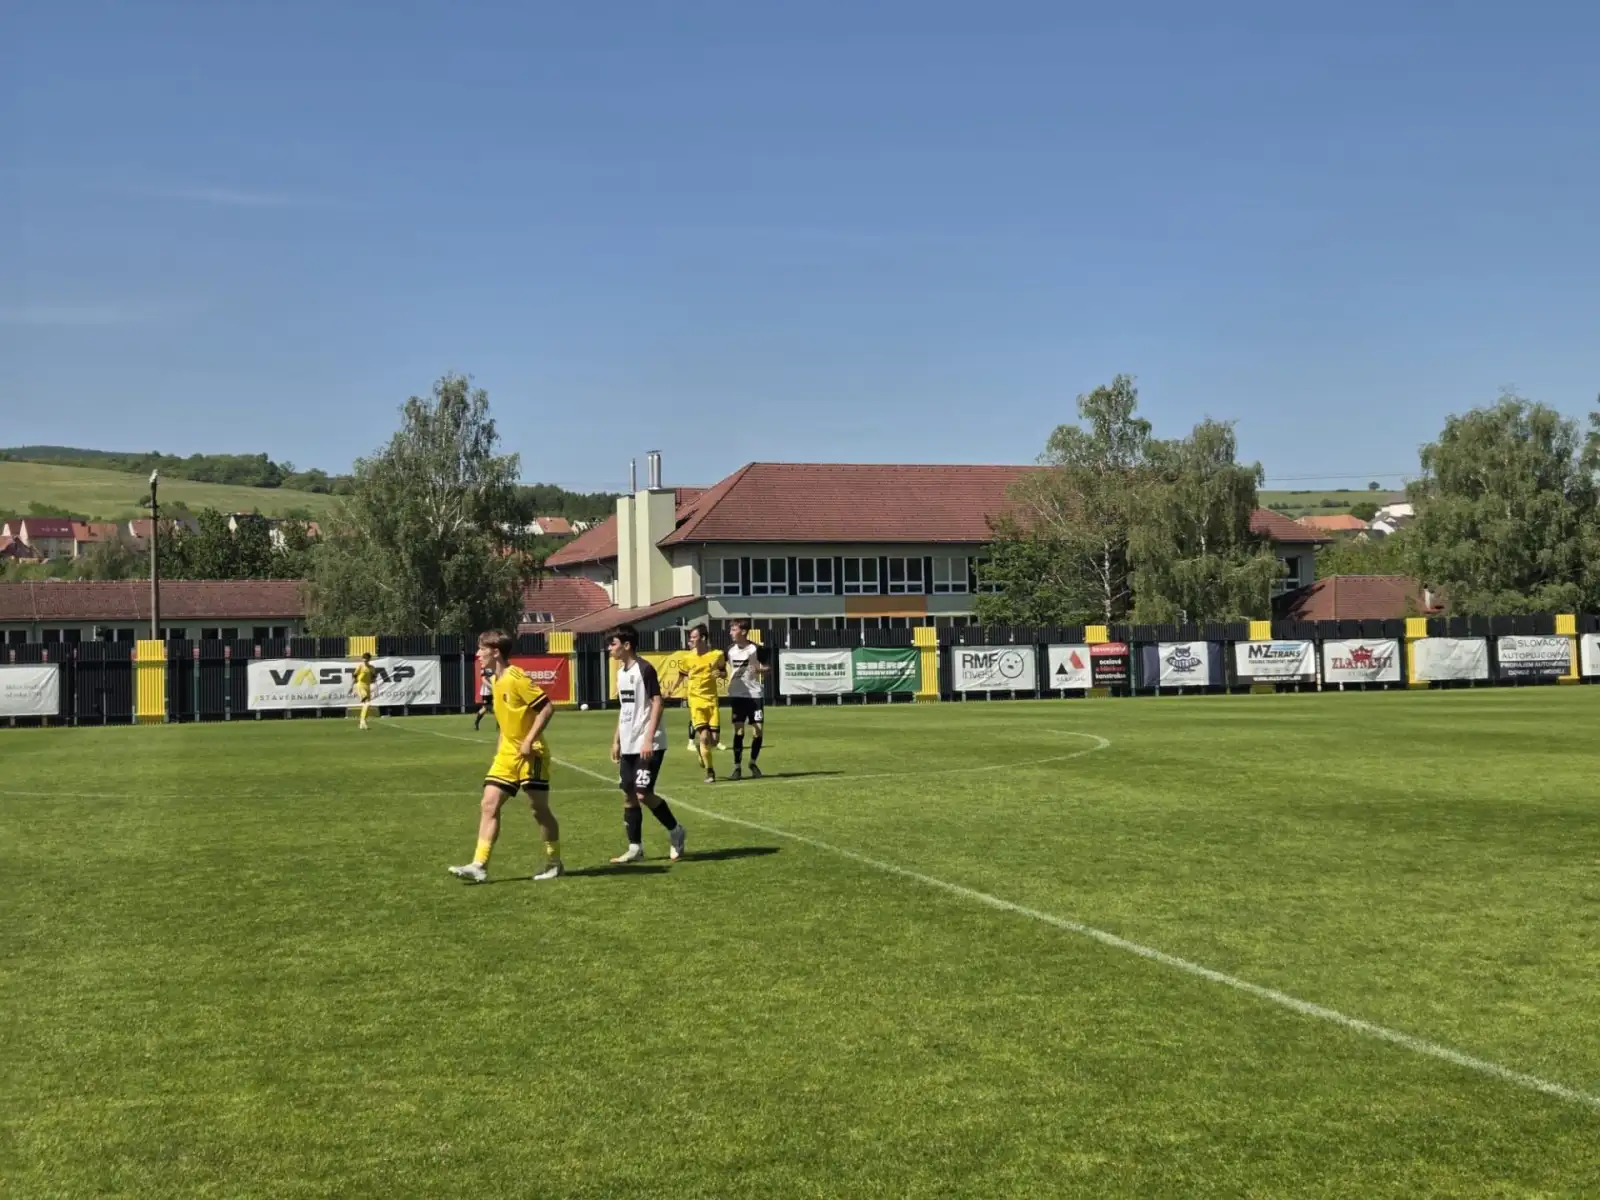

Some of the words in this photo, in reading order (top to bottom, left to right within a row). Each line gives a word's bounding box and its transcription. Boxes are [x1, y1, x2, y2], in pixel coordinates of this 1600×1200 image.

[1248, 645, 1272, 658] MZ
[962, 653, 999, 668] RMF
[635, 768, 650, 785] 25
